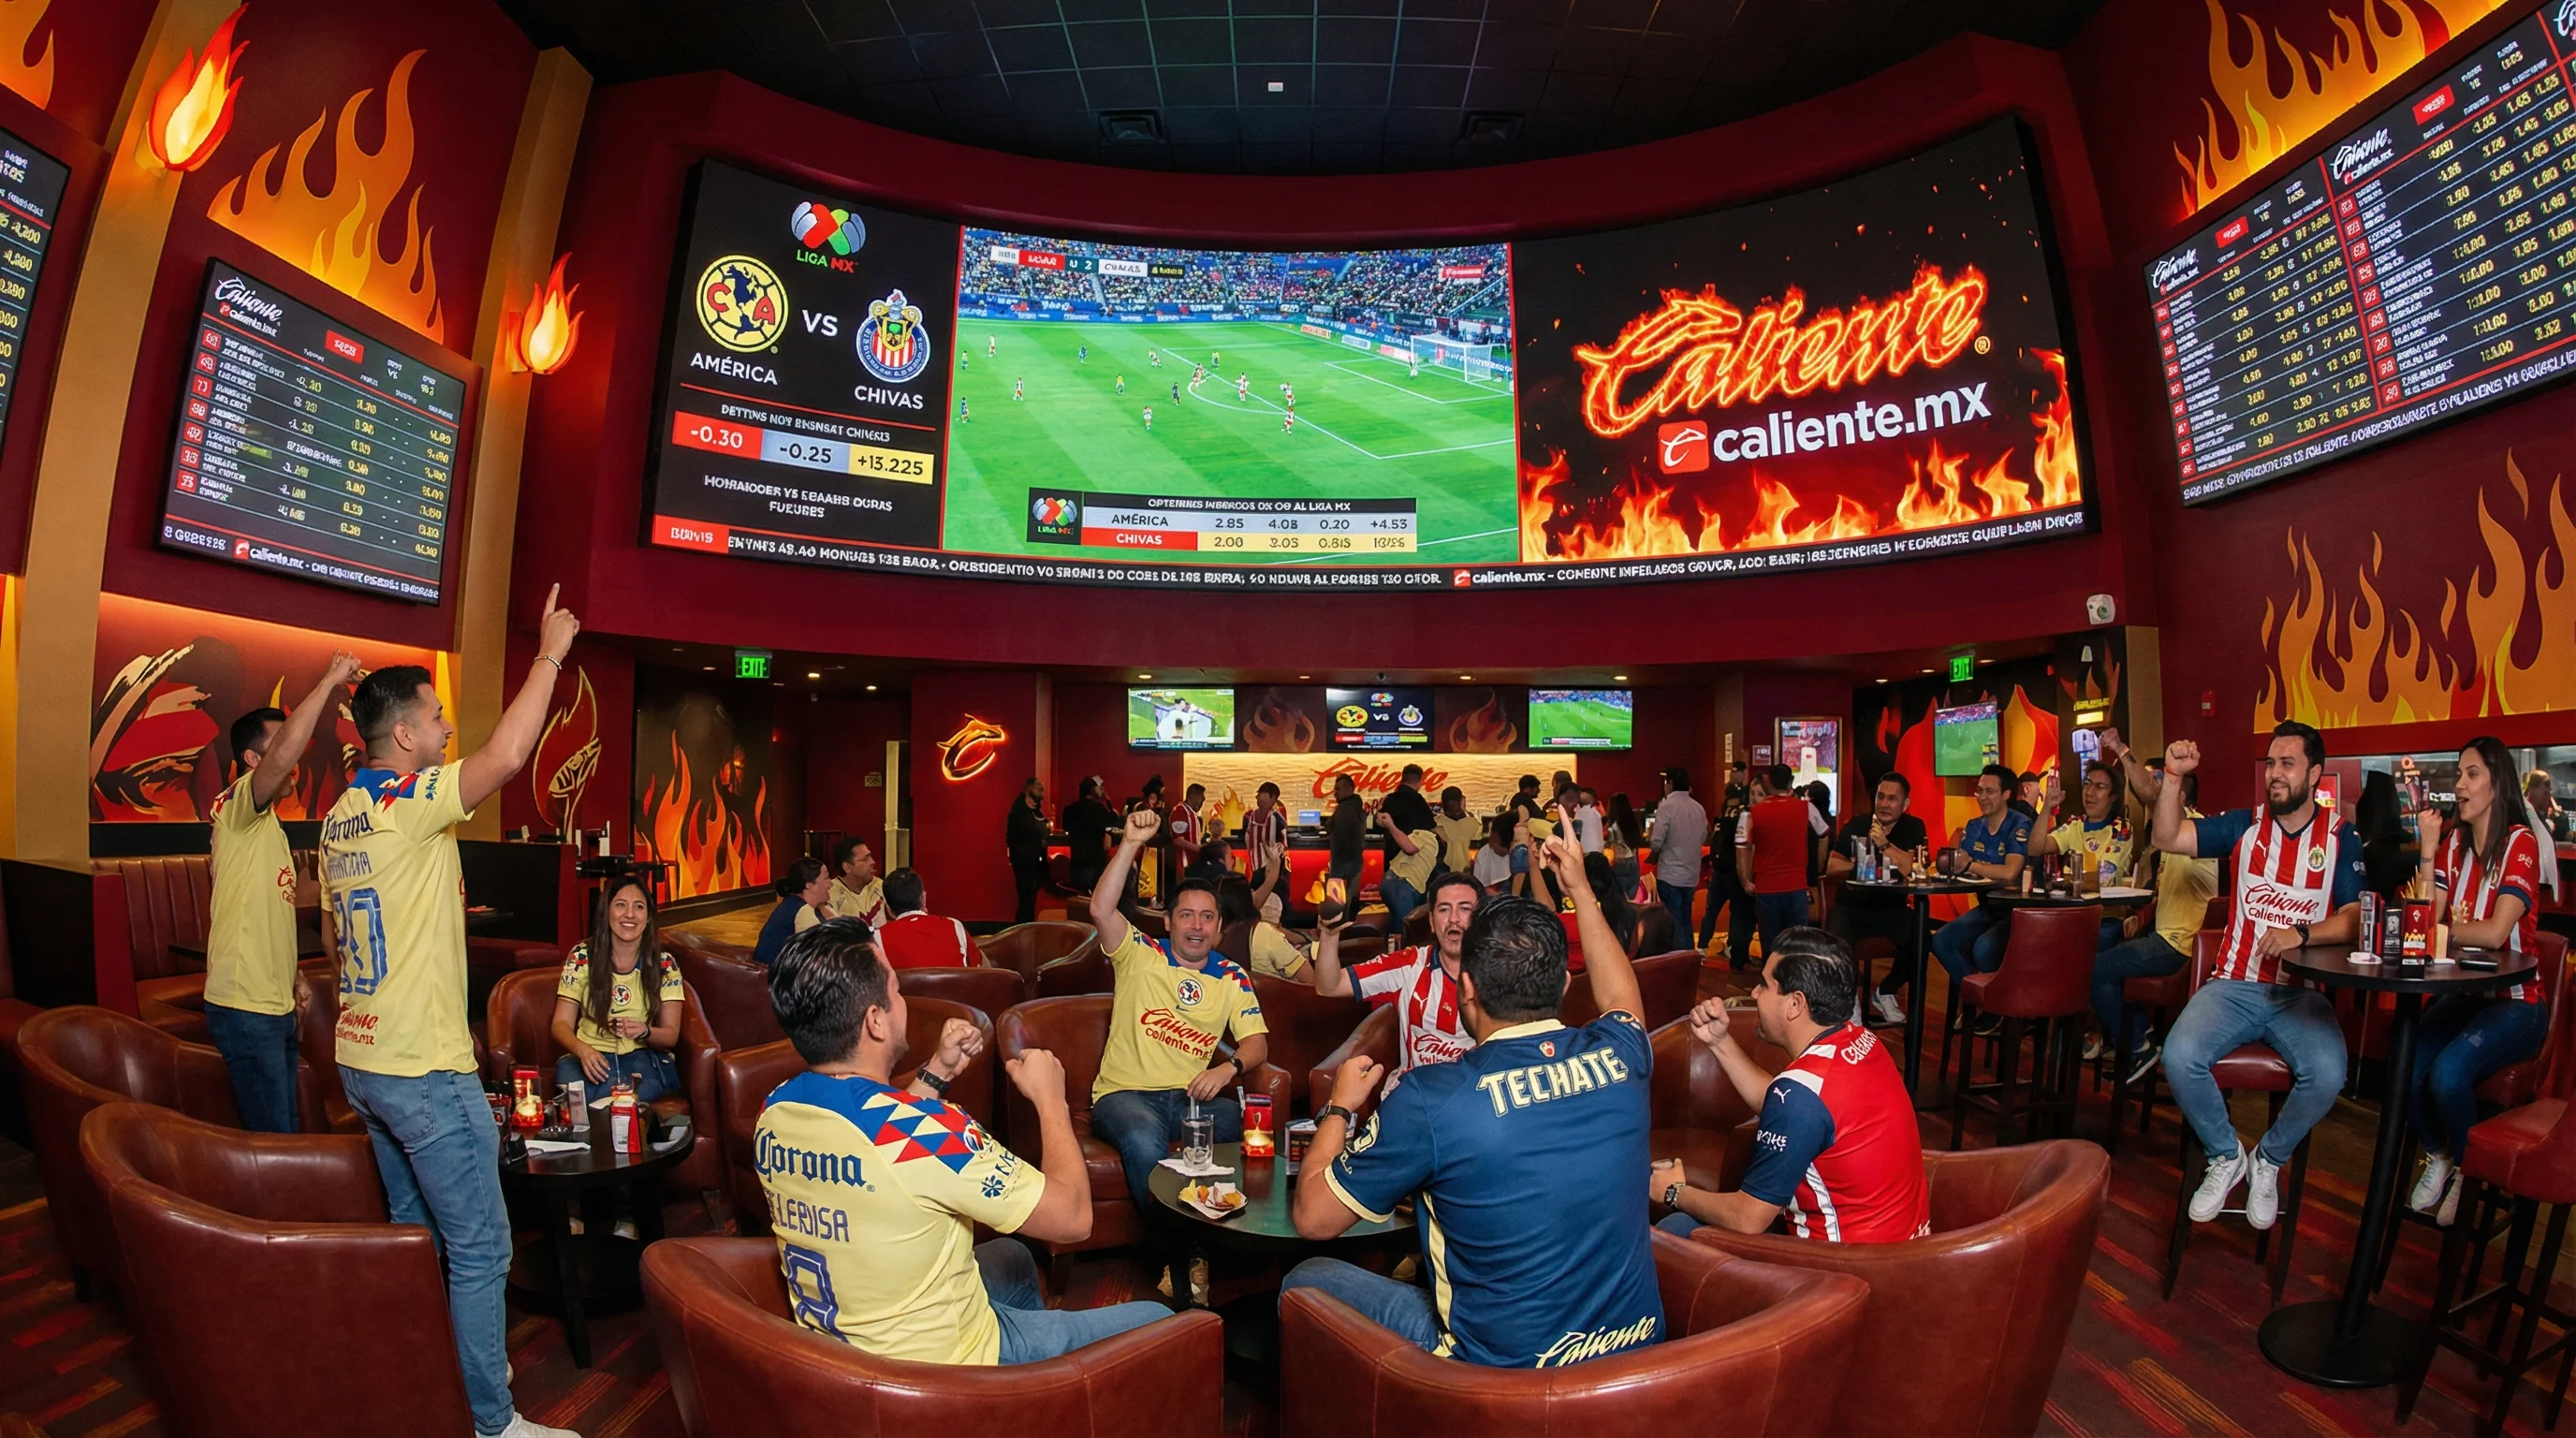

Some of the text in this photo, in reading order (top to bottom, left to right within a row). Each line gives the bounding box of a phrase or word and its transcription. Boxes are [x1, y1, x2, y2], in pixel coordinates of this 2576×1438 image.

[797, 249, 828, 267] LIGA
[801, 309, 839, 337] VS
[691, 352, 778, 386] AMÉRICA
[1577, 275, 1983, 434] Caliente
[854, 385, 924, 410] CHIVAS
[1713, 381, 1992, 462] caliente.mx
[690, 425, 743, 448] -0.30
[779, 442, 832, 463] -0.25
[1111, 514, 1169, 527] AMÉRICA
[1215, 518, 1244, 529] 2.85
[1116, 534, 1163, 545] CHIVAS
[741, 657, 765, 676] EXIT
[1310, 756, 1448, 799] Caliete
[1476, 1046, 1628, 1117] TECHATE
[754, 1127, 867, 1187] Corona
[1535, 1315, 1656, 1369] Caliente
